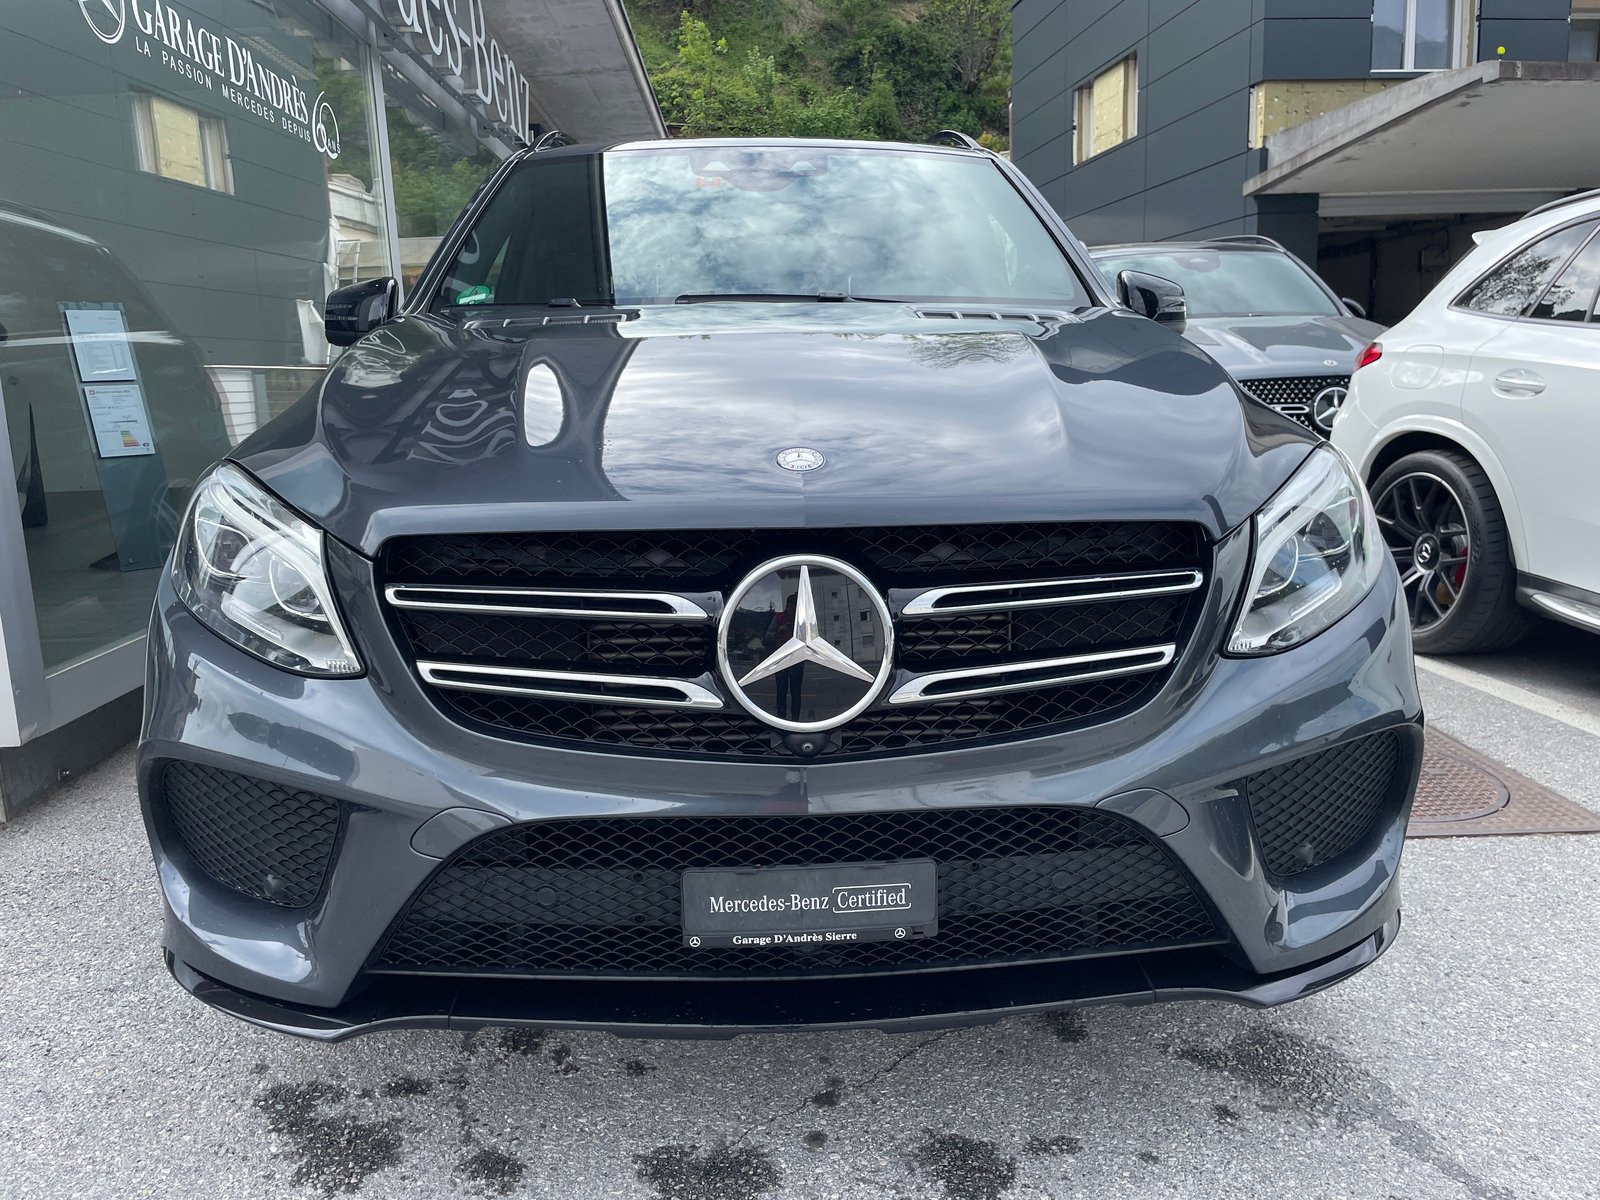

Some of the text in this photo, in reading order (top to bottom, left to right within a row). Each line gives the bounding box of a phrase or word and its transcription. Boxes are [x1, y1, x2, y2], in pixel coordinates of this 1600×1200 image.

[131, 0, 309, 125] GARAGE D'ANDRÈS
[135, 35, 152, 58] LA
[161, 50, 212, 90] PASSION
[221, 83, 275, 123] MERCEDES
[281, 116, 311, 143] DEPUIS
[709, 888, 907, 914] Mercedes-Benz Certified
[732, 931, 858, 948] Garage D'Andrès Sierre
